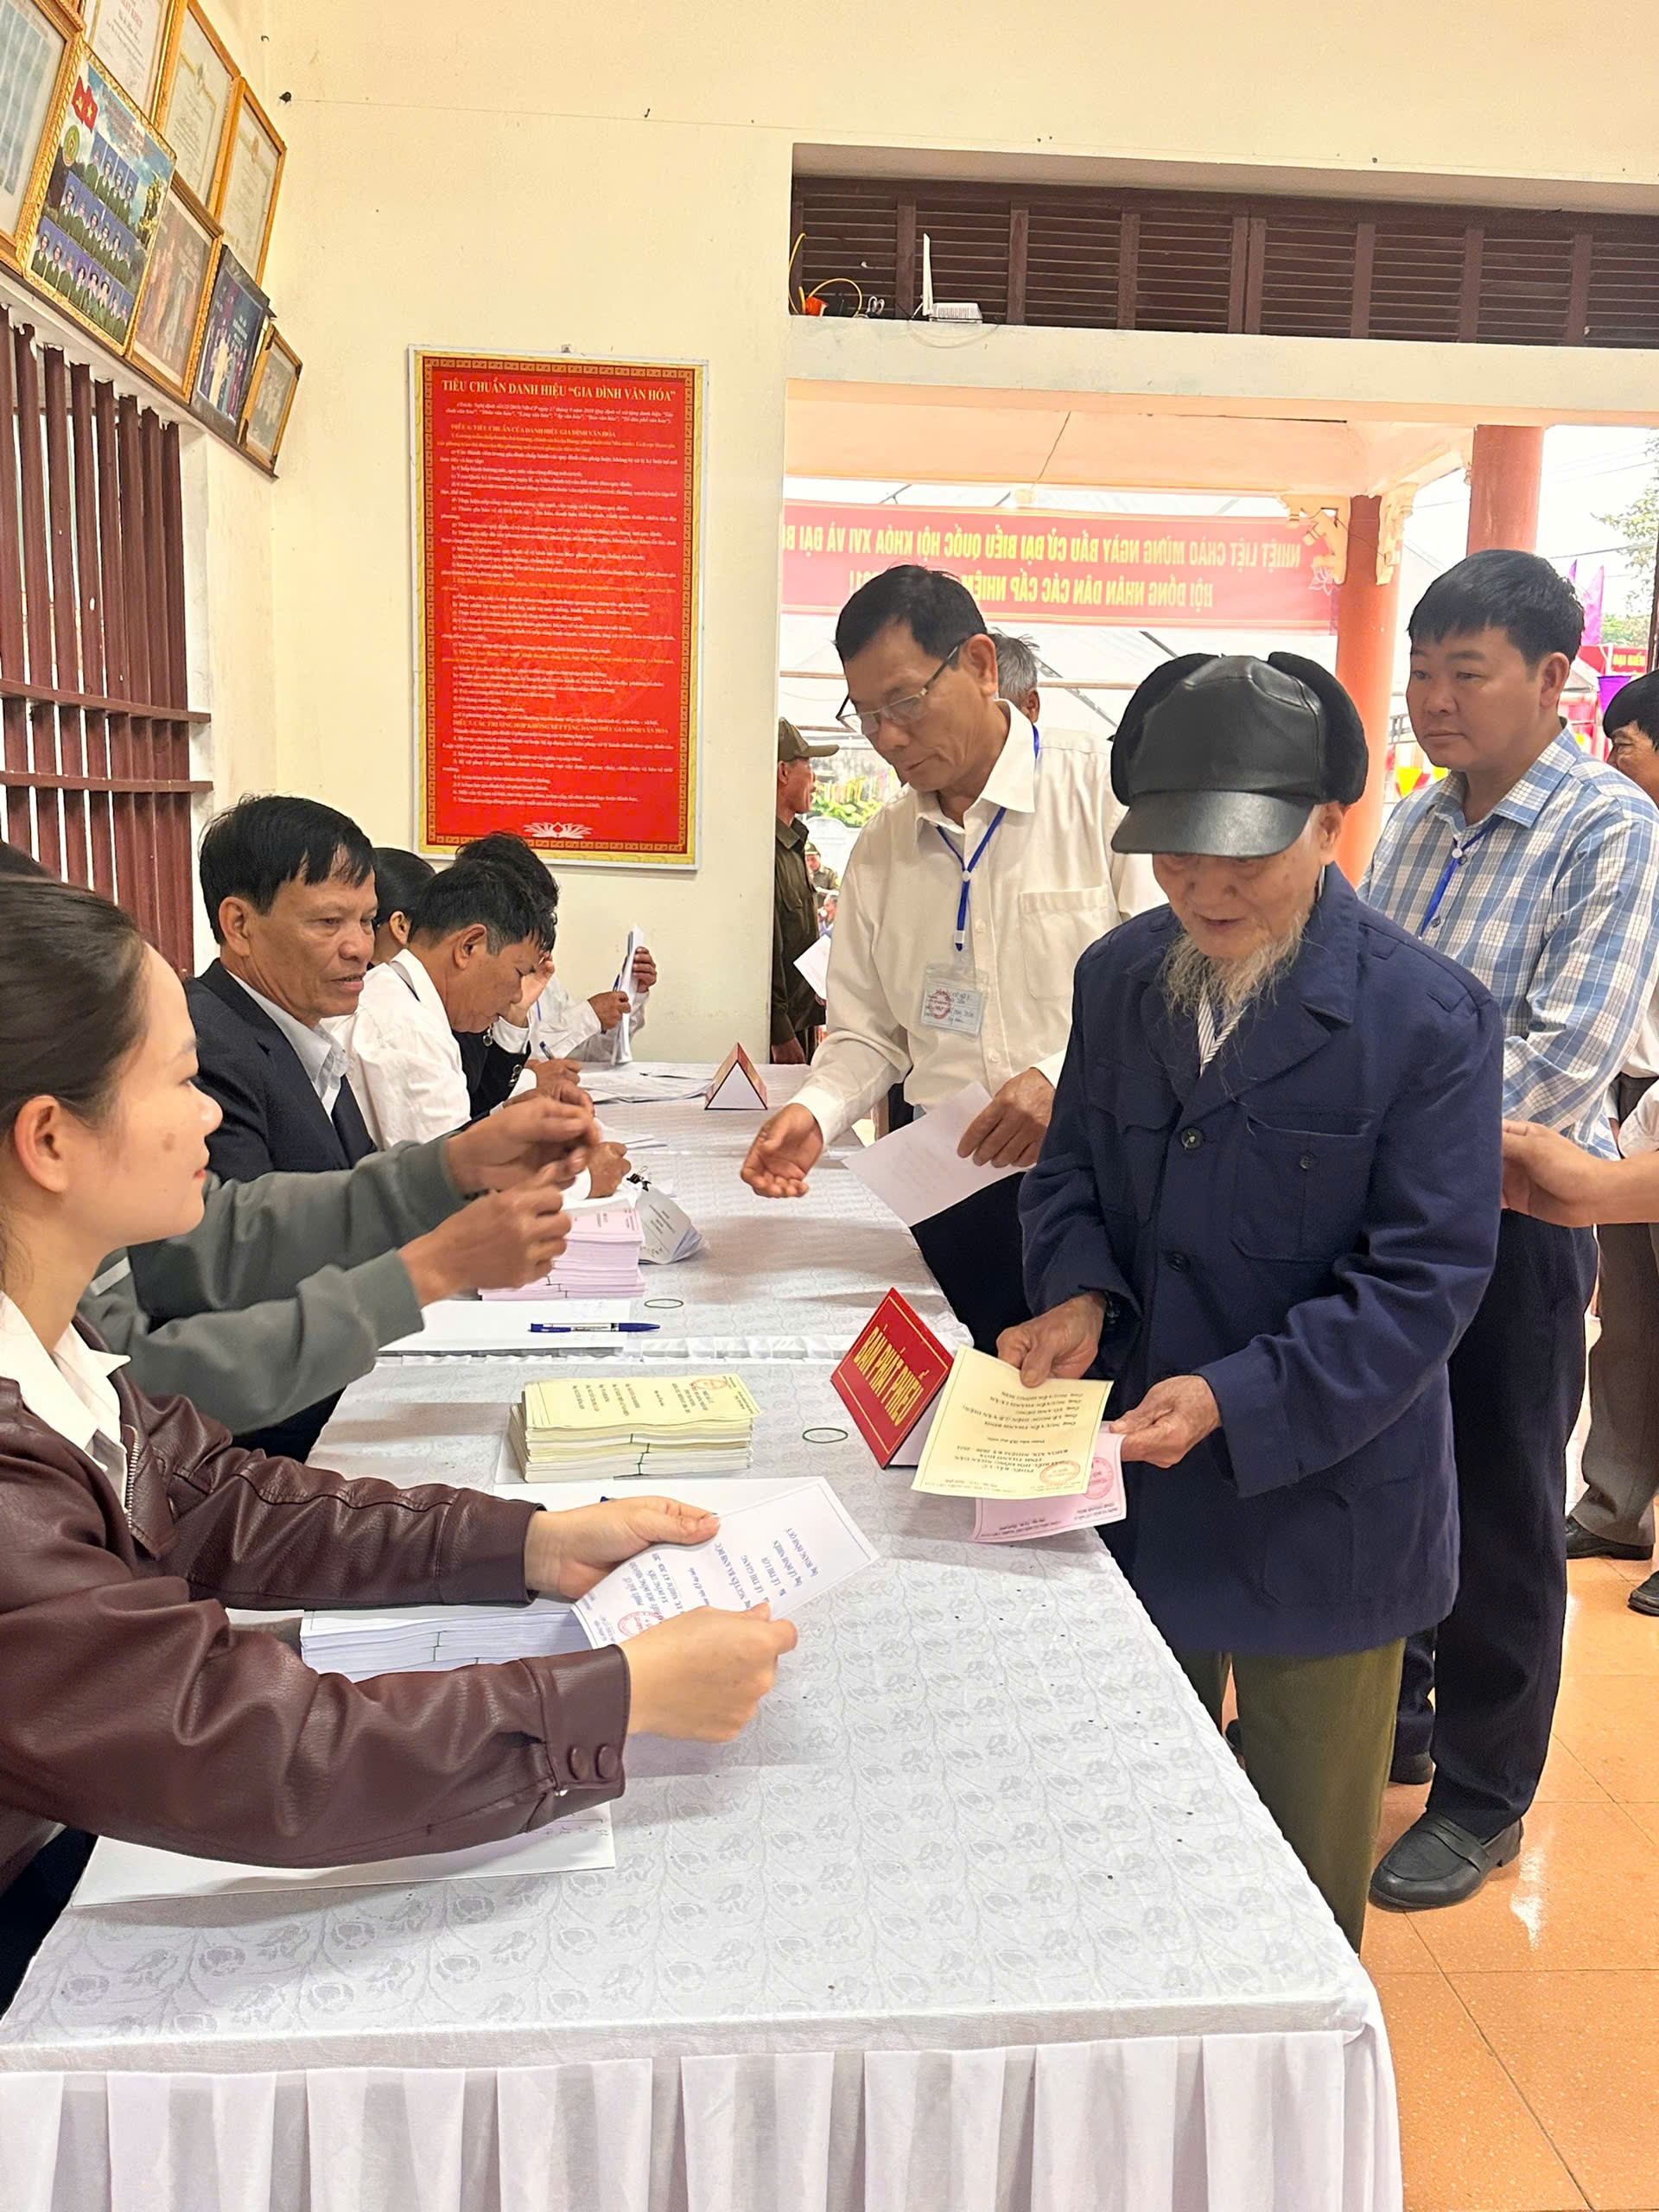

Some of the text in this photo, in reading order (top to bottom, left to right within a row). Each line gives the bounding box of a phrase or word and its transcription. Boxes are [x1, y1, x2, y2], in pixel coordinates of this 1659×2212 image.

[442, 378, 467, 391] TIÊU
[469, 377, 506, 393] CHUẨN
[508, 384, 538, 395] DANH
[541, 382, 567, 398] HIỆU
[596, 385, 621, 399] ĐÌNH
[625, 386, 645, 400] VĂN
[854, 1324, 930, 1427] BÀN PHÁT PHIẾU
